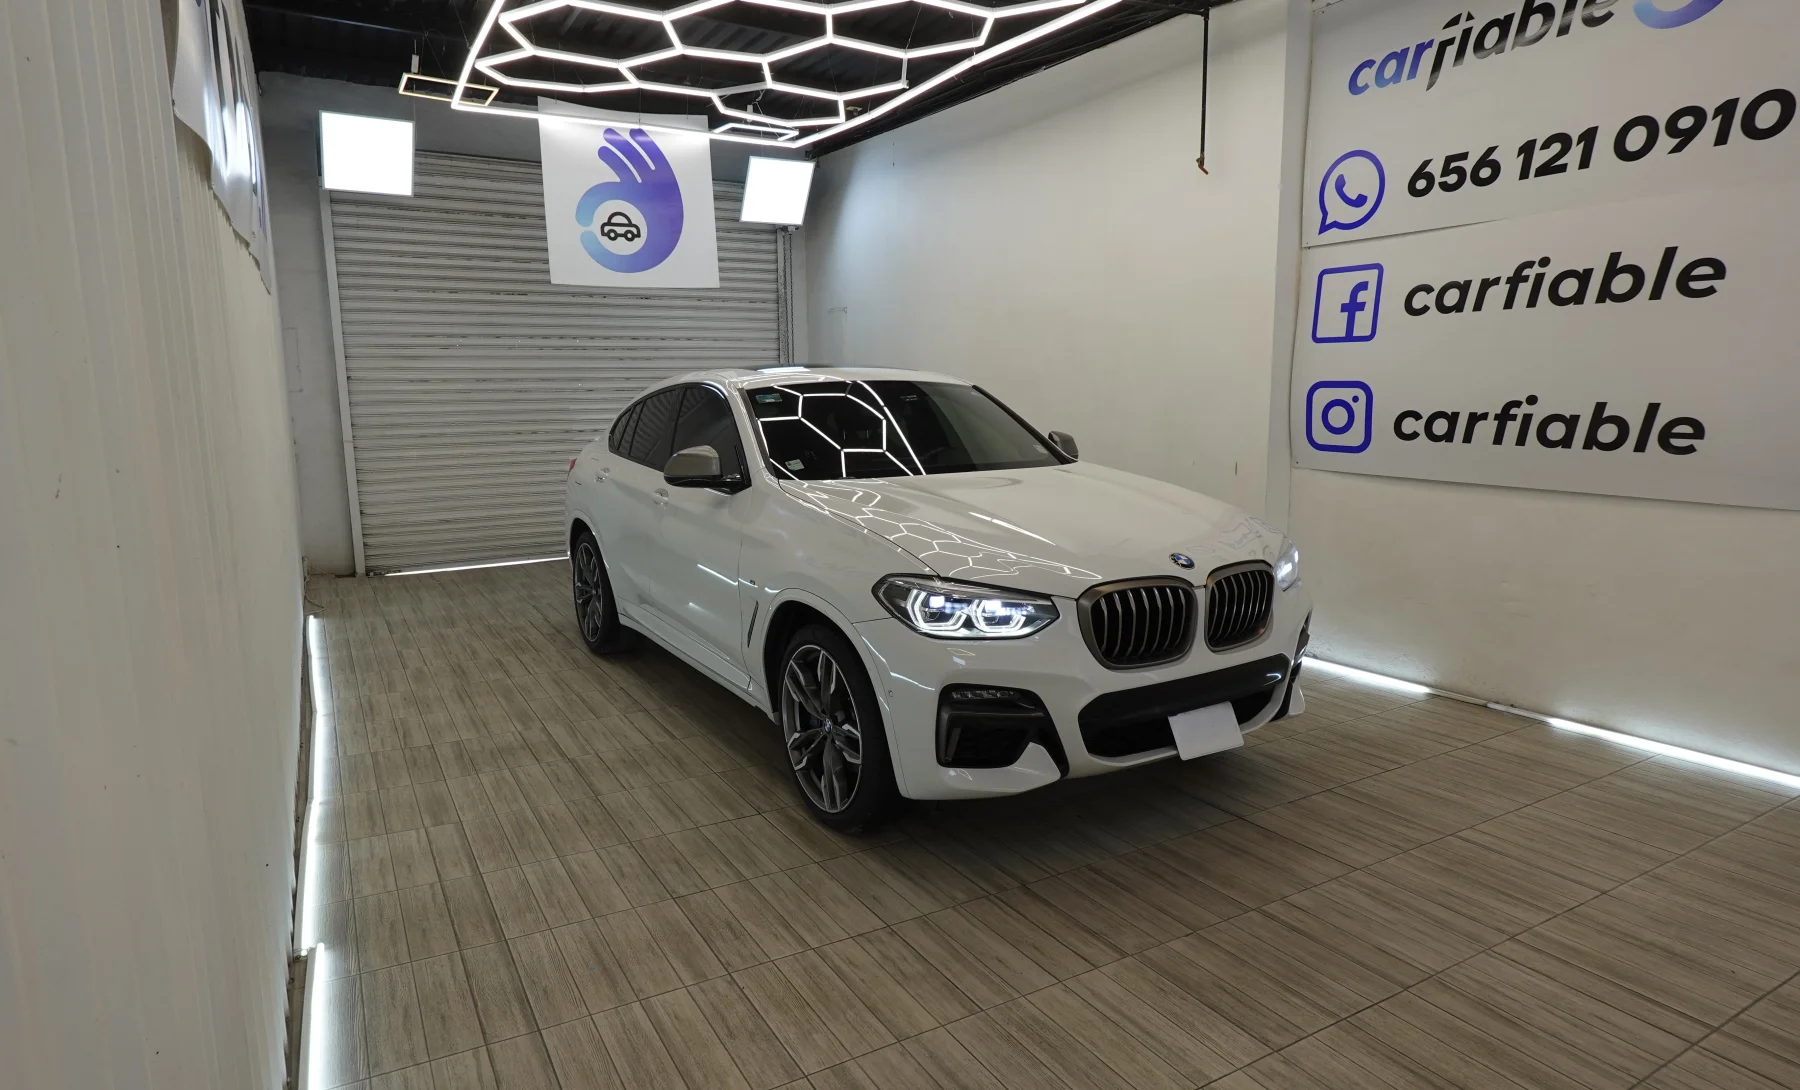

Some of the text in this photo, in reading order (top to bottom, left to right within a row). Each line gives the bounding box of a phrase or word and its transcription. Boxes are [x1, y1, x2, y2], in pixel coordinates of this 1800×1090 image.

[1407, 88, 1797, 198] 656 121 0910
[1403, 246, 1727, 317] carfiable
[1393, 395, 1706, 456] carfiable
